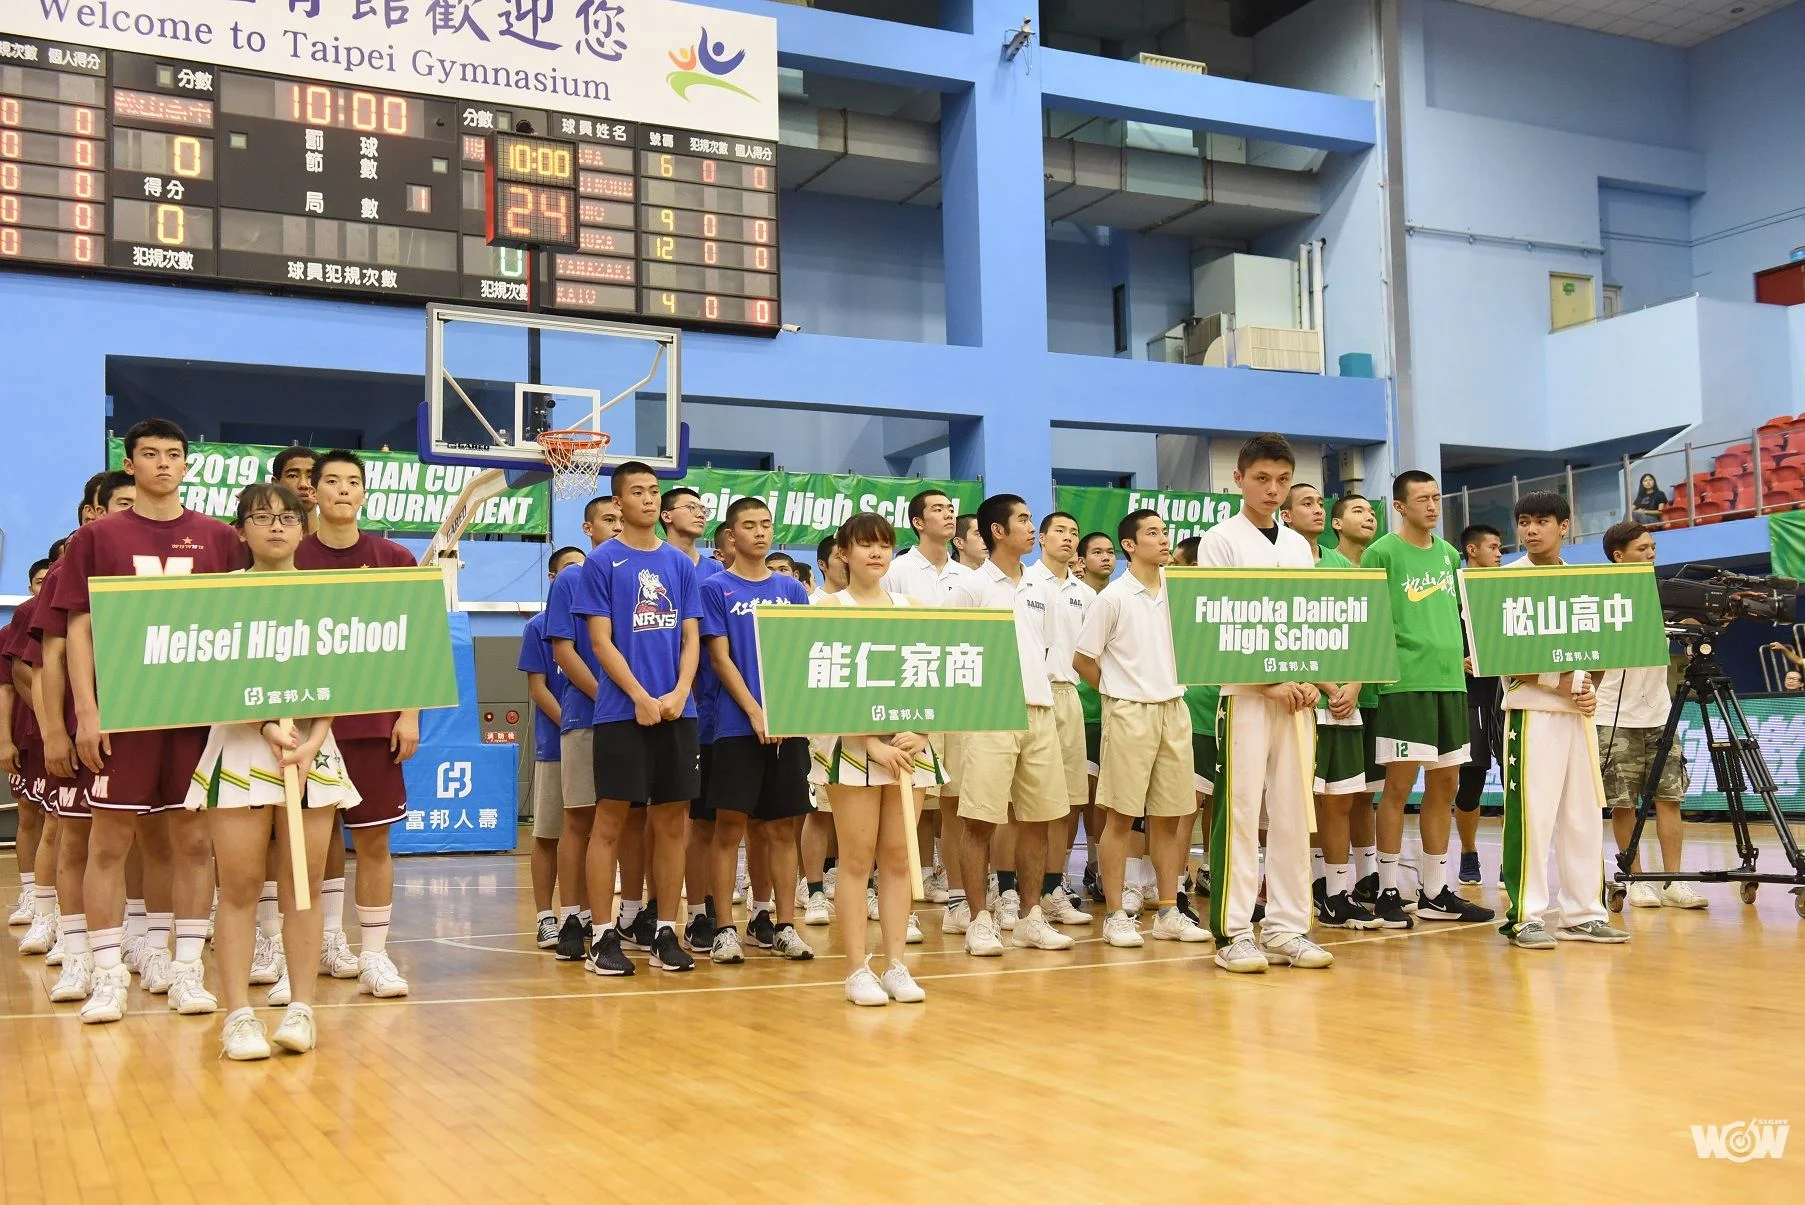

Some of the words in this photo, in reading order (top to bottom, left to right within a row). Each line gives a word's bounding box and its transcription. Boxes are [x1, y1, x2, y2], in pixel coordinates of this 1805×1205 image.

[40, 0, 212, 44] Welcome
[230, 21, 266, 52] to
[283, 30, 396, 72] Taipei
[412, 50, 611, 101] Gymnasium
[48, 47, 100, 70] 個人得分
[177, 69, 213, 91] 分數
[2, 99, 19, 125] 0
[76, 108, 92, 134] 0
[293, 85, 407, 134] 10:00
[463, 108, 494, 129] 分數
[561, 118, 627, 141] 球員姓名
[2, 131, 19, 158] 0
[76, 140, 92, 166] 0
[174, 136, 200, 176] 0
[509, 144, 570, 178] 10:00
[649, 132, 674, 148] 號碼
[690, 137, 728, 155] 犯規次數
[735, 143, 772, 161] 個人得分
[1, 164, 18, 190] 0
[75, 171, 91, 198] 0
[660, 155, 673, 177] 6
[703, 160, 716, 182] 0
[754, 166, 766, 189] 0
[144, 177, 185, 200] 得分
[1, 196, 18, 222] 0
[75, 203, 91, 229] 0
[157, 204, 184, 245] 0
[507, 187, 567, 236] 24
[661, 209, 674, 231] 9
[704, 214, 716, 237] 0
[755, 220, 767, 242] 0
[1, 228, 18, 255] 0
[75, 235, 91, 261] 0
[133, 247, 194, 271] 犯規次數
[656, 237, 674, 260] 12
[704, 242, 716, 264] 0
[756, 247, 767, 269] 0
[287, 260, 398, 288] 球員犯規次數
[662, 293, 675, 313] 4
[706, 296, 717, 319] 0
[757, 301, 768, 323] 0
[183, 453, 260, 485] 2019
[783, 491, 853, 530] High
[1195, 596, 1288, 623] Fukuoka
[1292, 596, 1368, 623] Daiichi
[1502, 593, 1633, 637] 松山高中
[143, 622, 242, 665] Meisei
[247, 619, 311, 663] High
[316, 615, 408, 655] School
[1218, 624, 1269, 655] High
[1274, 623, 1349, 651] School
[807, 641, 984, 688] 能仁家商
[1278, 660, 1319, 672] 富邦人壽
[1564, 650, 1600, 662] 富邦人壽
[267, 687, 331, 705] 富邦人壽
[888, 708, 935, 721] 富邦人壽
[1396, 742, 1408, 758] 12
[405, 808, 498, 830] 富邦人壽
